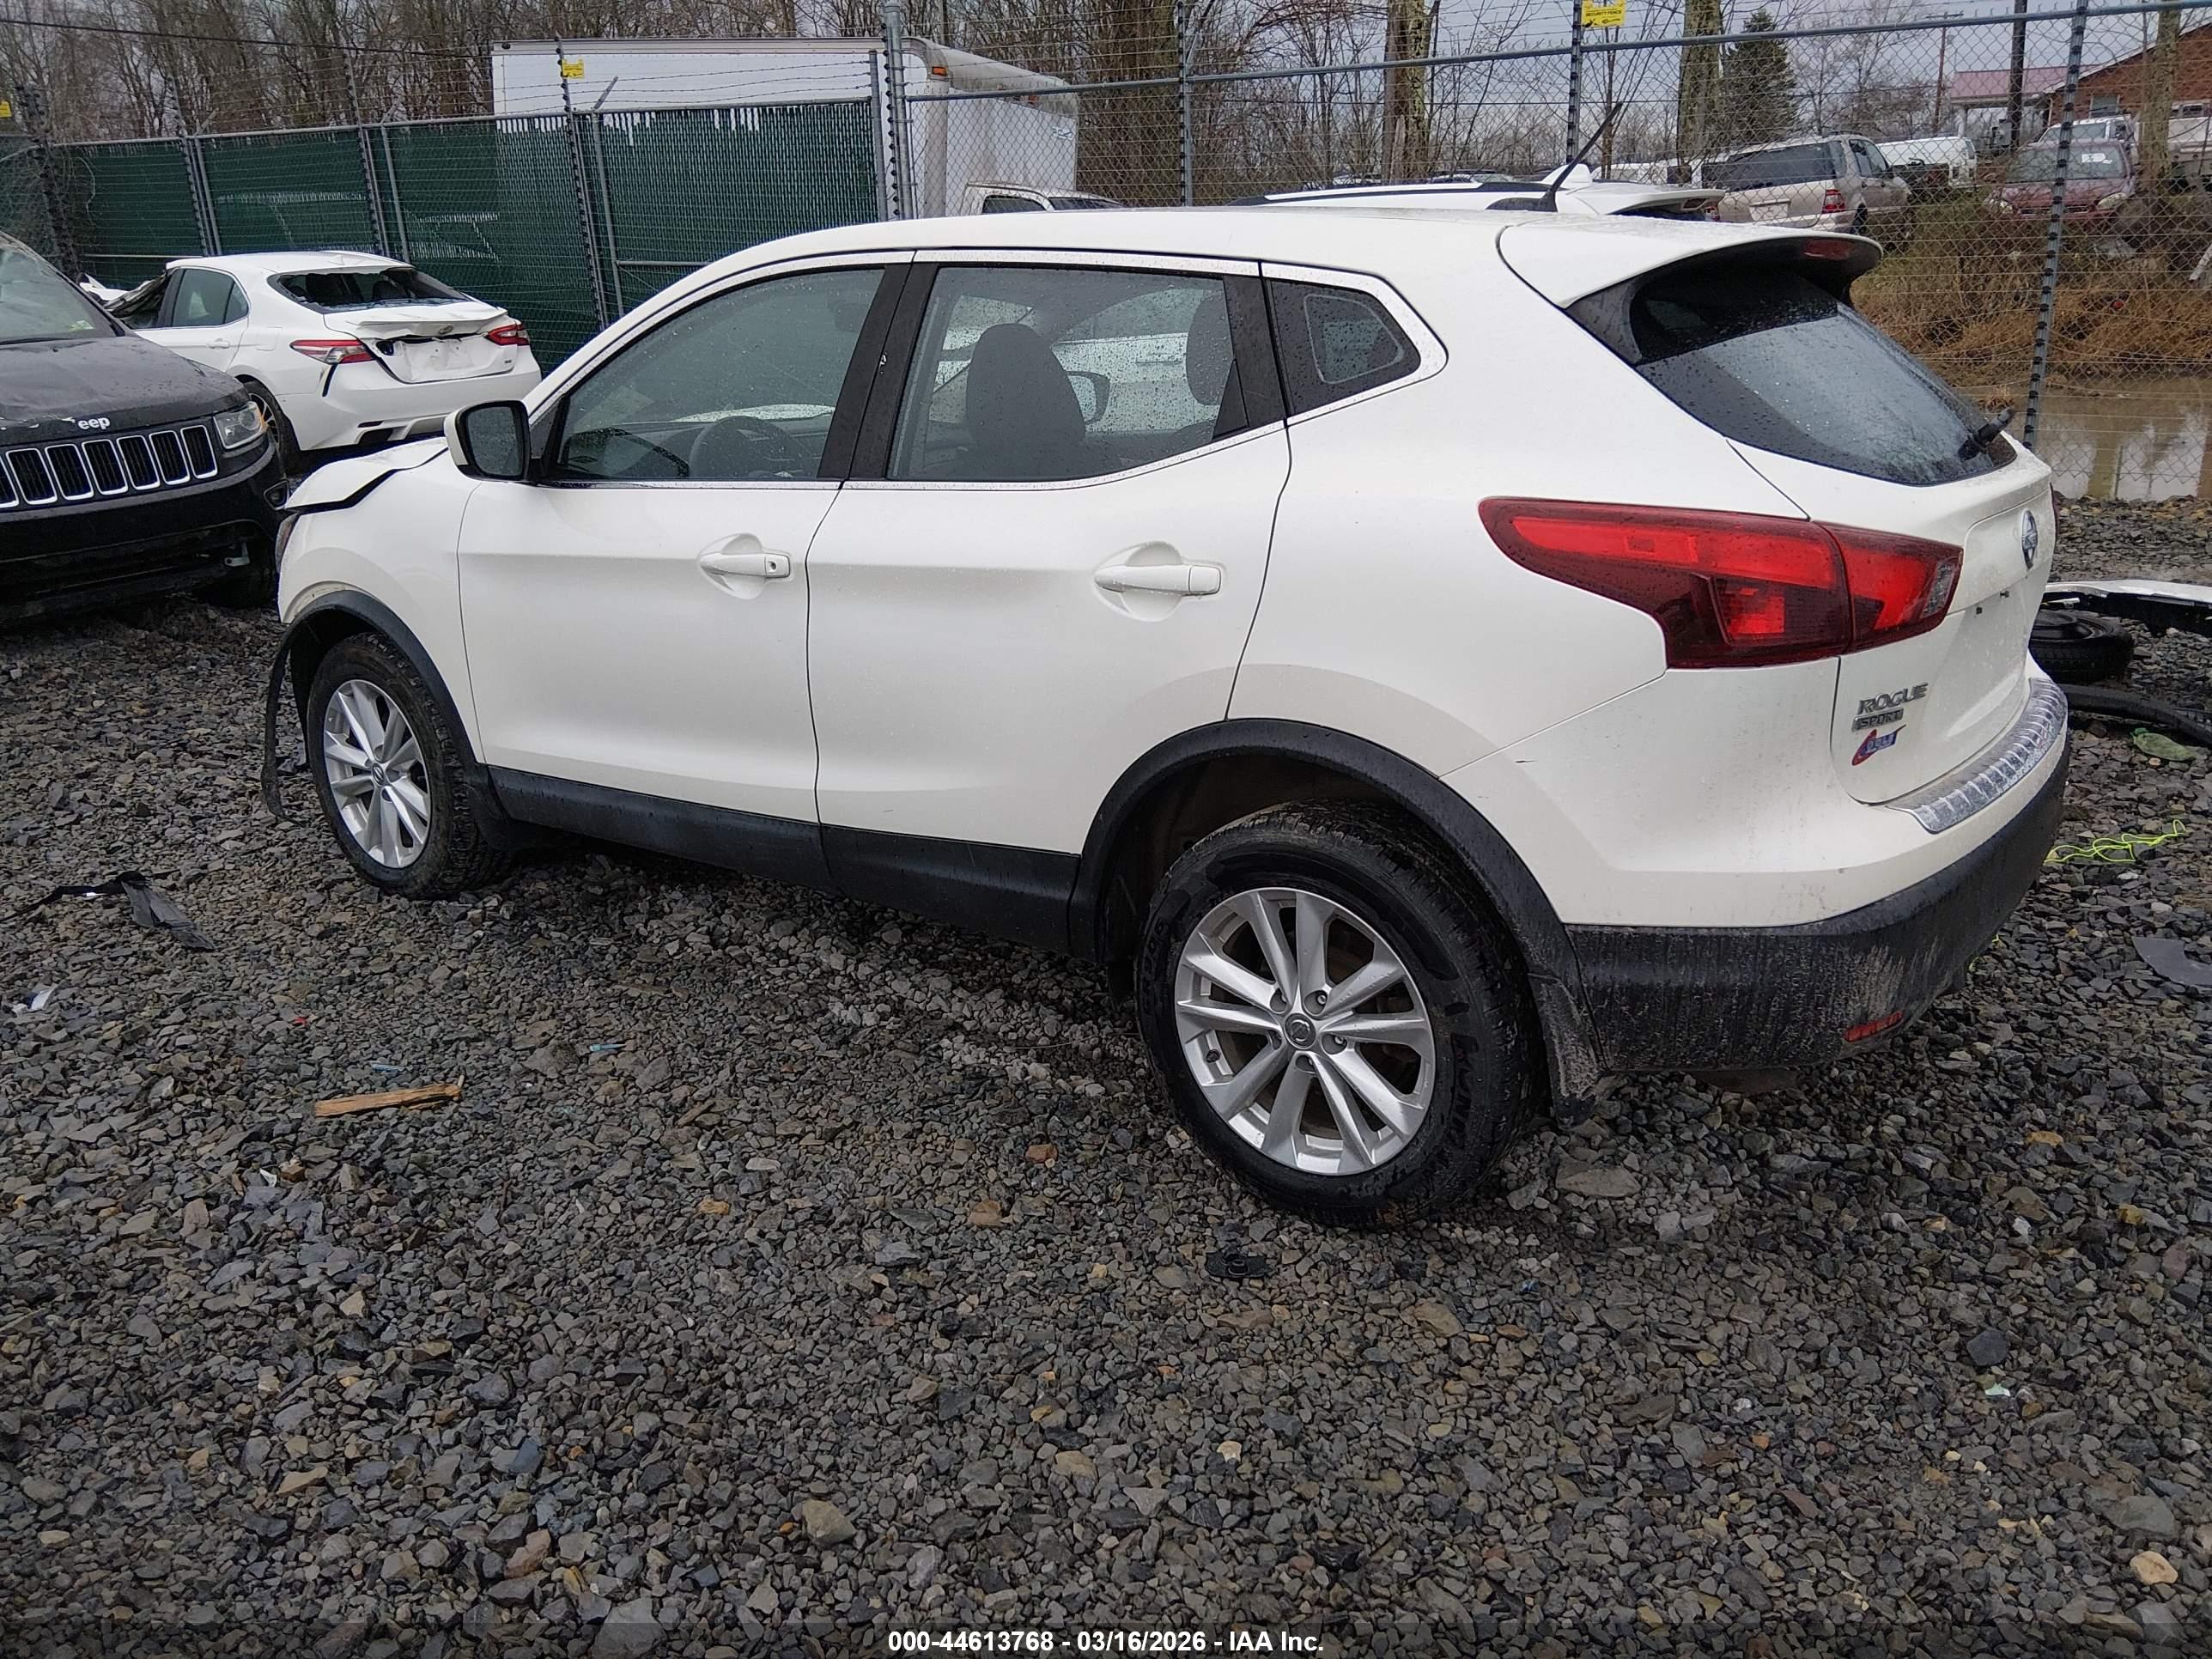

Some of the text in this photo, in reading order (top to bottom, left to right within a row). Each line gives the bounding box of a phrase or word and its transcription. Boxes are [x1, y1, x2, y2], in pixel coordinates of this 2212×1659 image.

[76, 416, 111, 430] eep
[1856, 681, 1929, 715] ROGUE
[1858, 709, 1901, 730] SPORT
